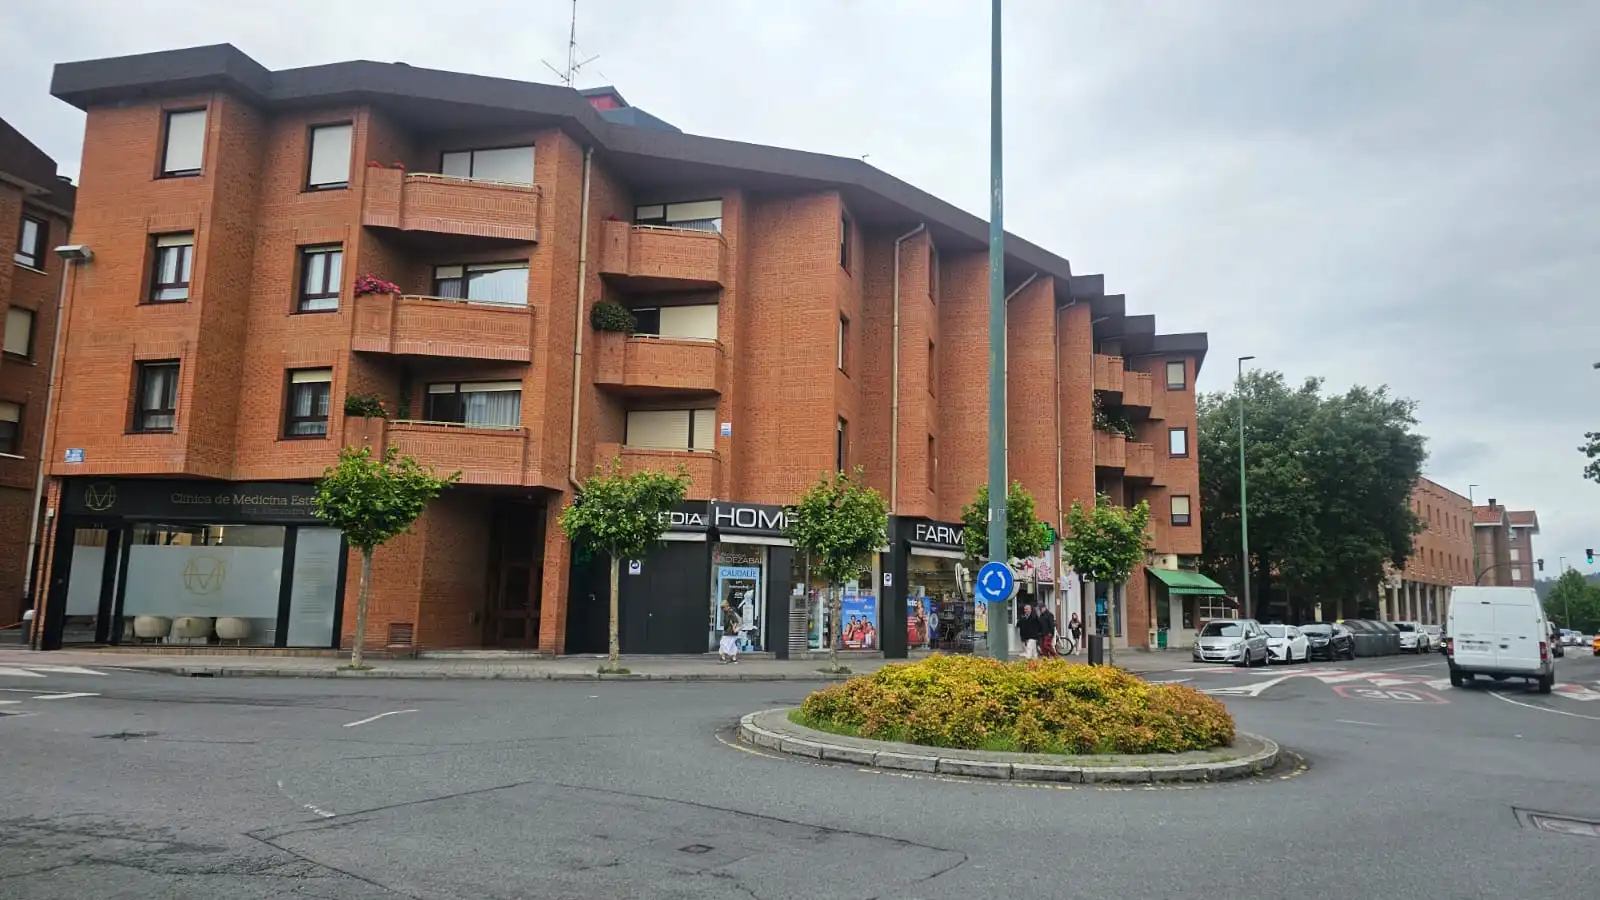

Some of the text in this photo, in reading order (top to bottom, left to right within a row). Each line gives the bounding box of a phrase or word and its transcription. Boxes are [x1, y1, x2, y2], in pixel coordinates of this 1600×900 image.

[215, 494, 230, 504] de
[233, 494, 287, 506] Medicina
[916, 524, 964, 545] FARM
